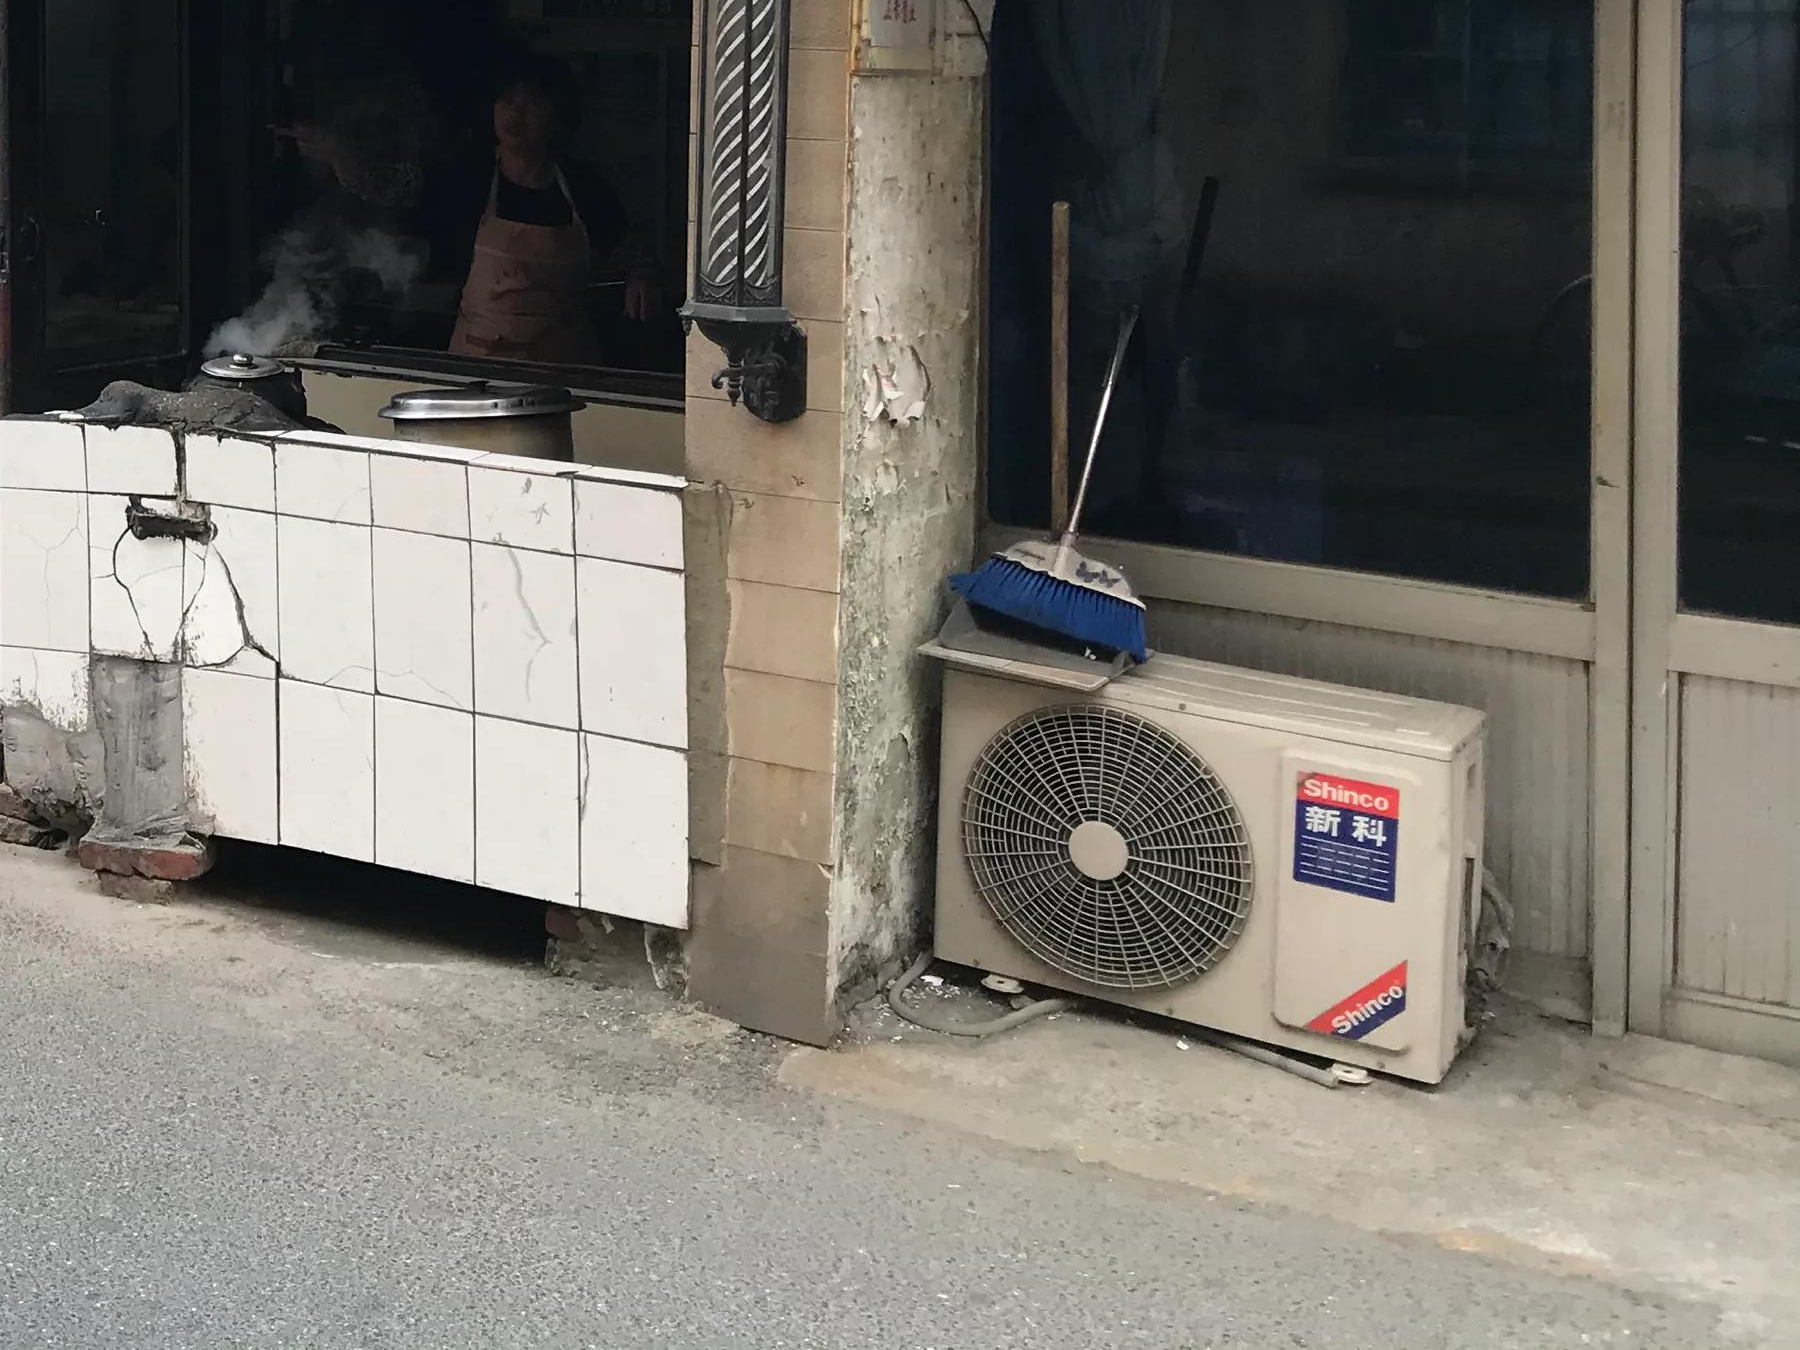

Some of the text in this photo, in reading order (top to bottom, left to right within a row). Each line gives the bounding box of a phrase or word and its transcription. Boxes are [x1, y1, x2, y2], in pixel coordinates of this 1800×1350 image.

[1303, 778, 1389, 811] Shinco
[1305, 805, 1387, 847] 新科
[1331, 984, 1404, 1035] Shinco
